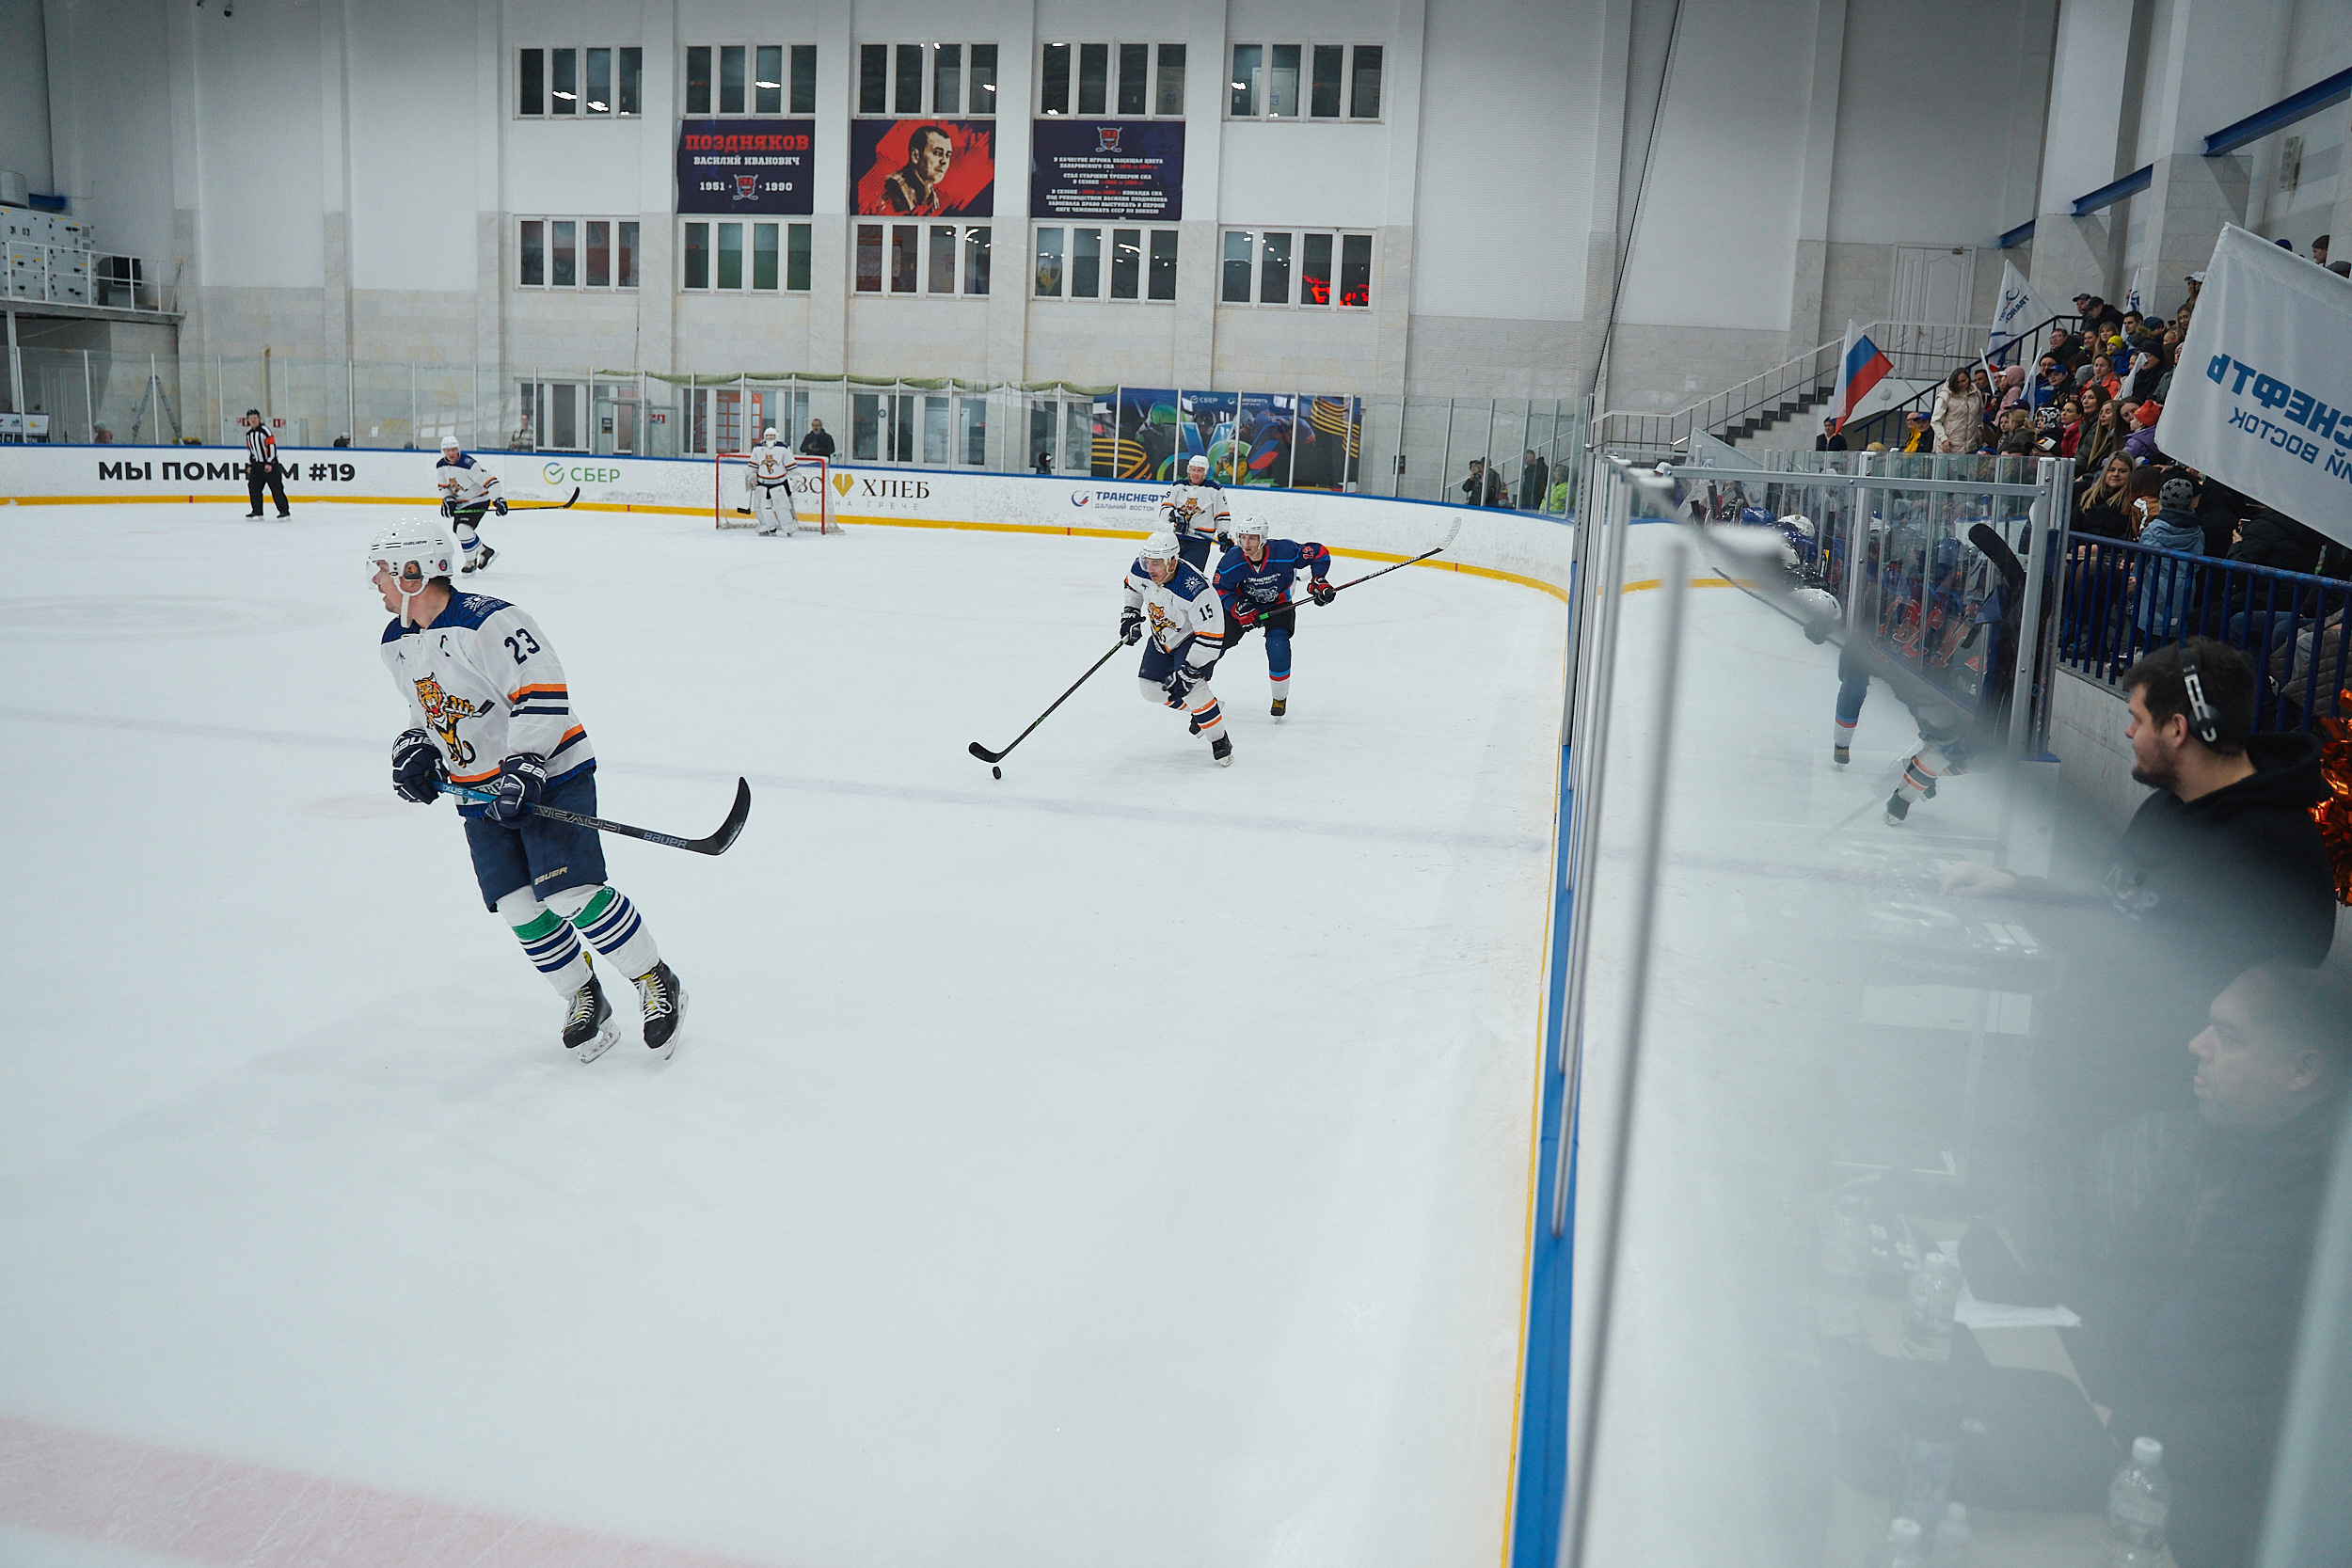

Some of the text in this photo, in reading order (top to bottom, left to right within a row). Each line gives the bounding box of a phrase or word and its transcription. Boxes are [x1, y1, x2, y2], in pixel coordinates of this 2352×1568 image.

[685, 135, 810, 153] ПОЗДНЯКОВ
[693, 155, 800, 166] ВАСИЛИЙ ИВАНОВИЧ
[699, 182, 725, 191] 1951
[765, 182, 793, 192] 1990
[99, 462, 356, 482] МЫ ПОМНМ #19
[570, 467, 621, 483] СБЕР
[862, 479, 930, 499] ХЛЕБ
[1096, 491, 1166, 504] ТРАНСНЕФТ
[1095, 502, 1126, 511] ДАЛЬНИЙ
[1200, 604, 1214, 622] 15
[504, 628, 541, 665] 23
